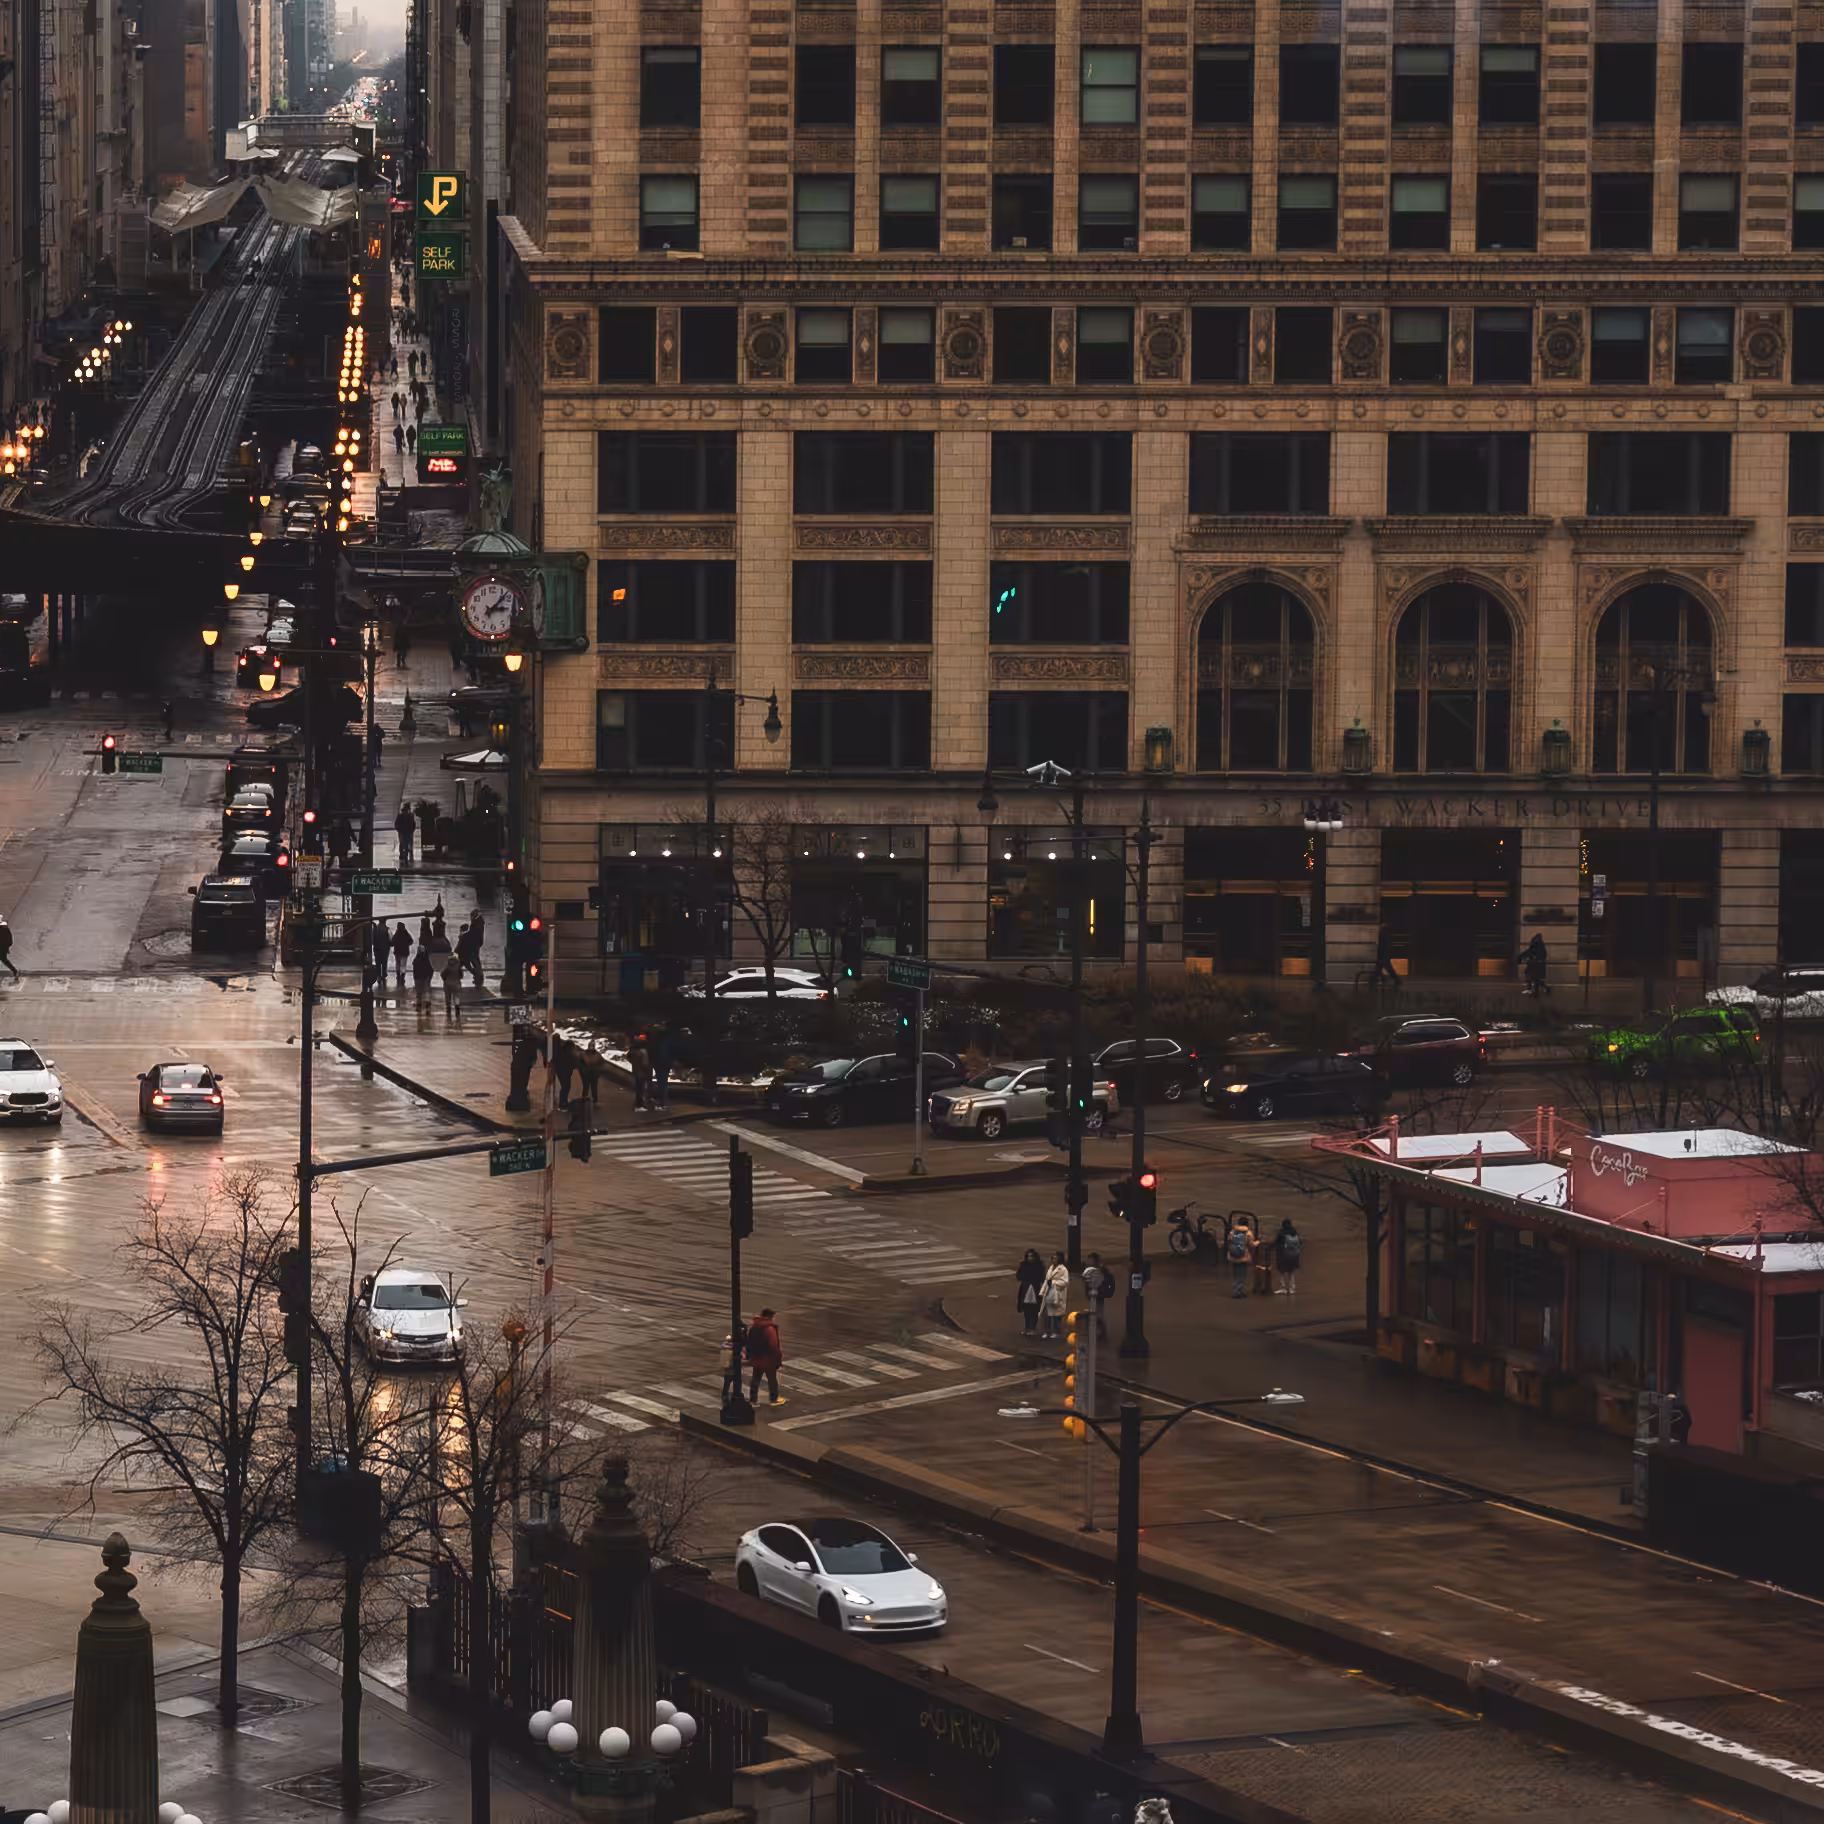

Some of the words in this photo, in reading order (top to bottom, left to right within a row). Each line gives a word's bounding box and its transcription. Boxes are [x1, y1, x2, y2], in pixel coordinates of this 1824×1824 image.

[422, 246, 452, 258] SELF
[422, 259, 455, 270] PARK
[1258, 798, 1282, 818] 35
[1395, 799, 1529, 818] WACKER
[1552, 799, 1649, 818] DRIVE
[360, 877, 392, 885] WACKER
[499, 1150, 535, 1163] WACKER
